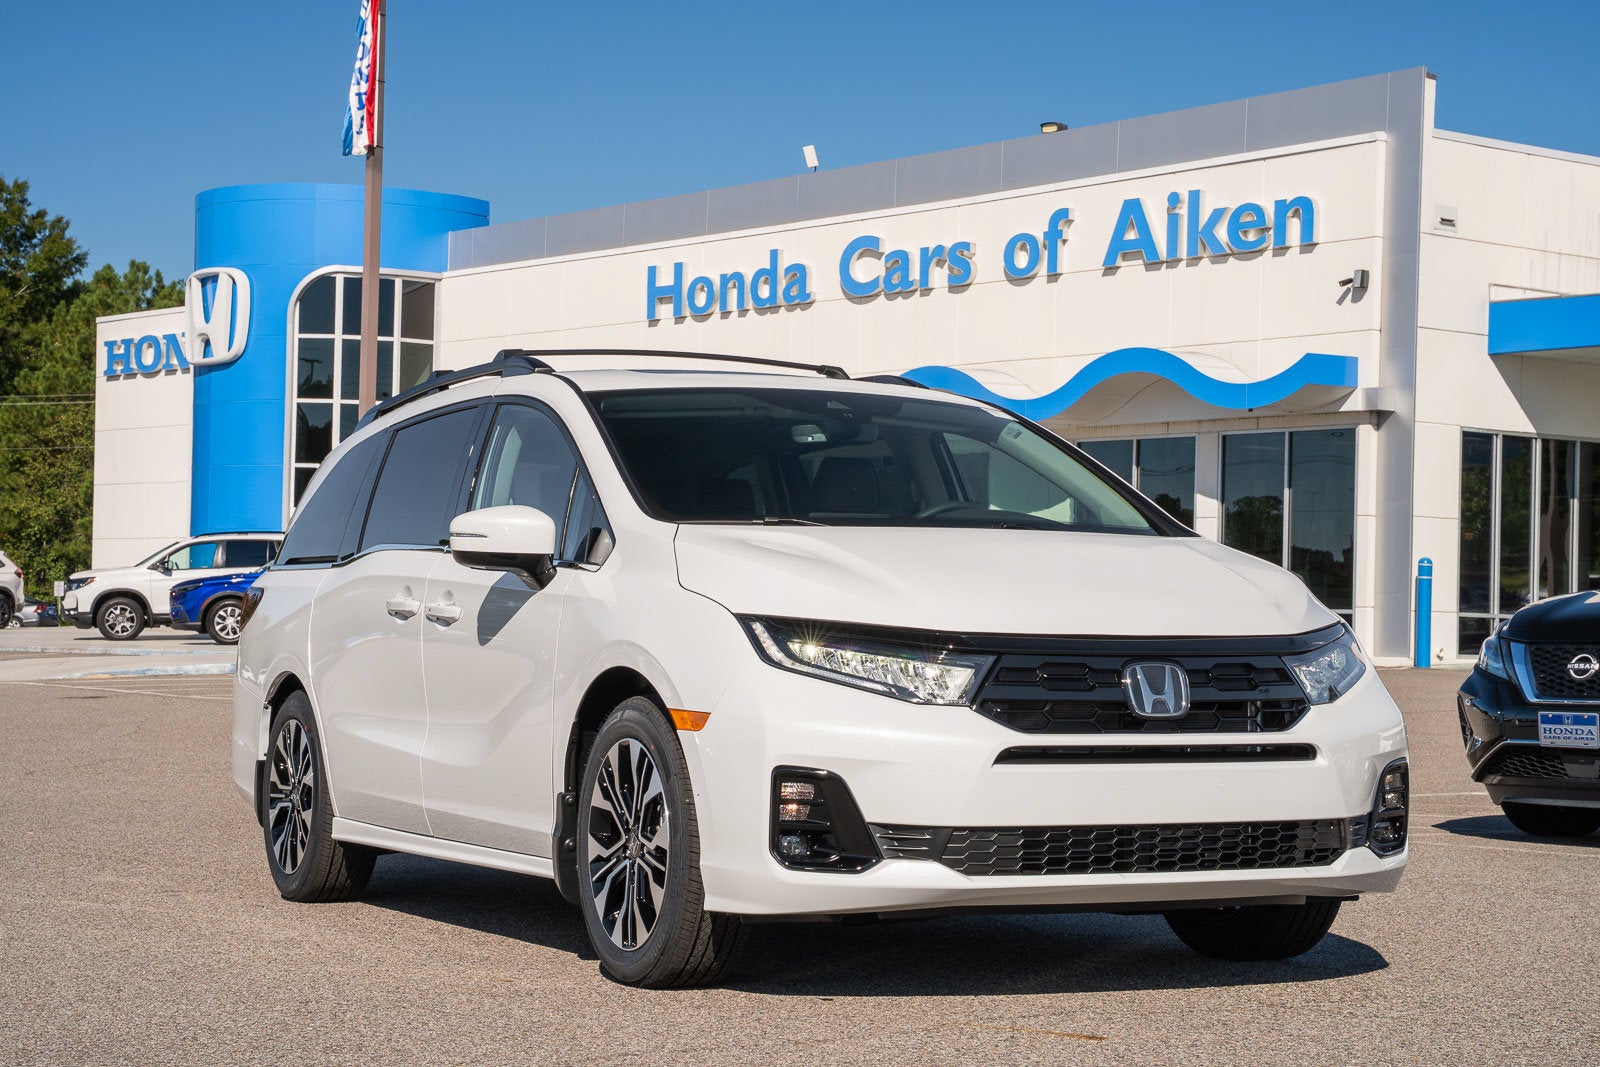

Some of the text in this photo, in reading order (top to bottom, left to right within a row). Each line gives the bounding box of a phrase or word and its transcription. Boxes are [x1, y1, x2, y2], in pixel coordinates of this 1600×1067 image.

[646, 189, 1316, 320] Honda Cars of Aiken
[1567, 663, 1599, 671] NISSAN
[1543, 727, 1595, 736] HONDA
